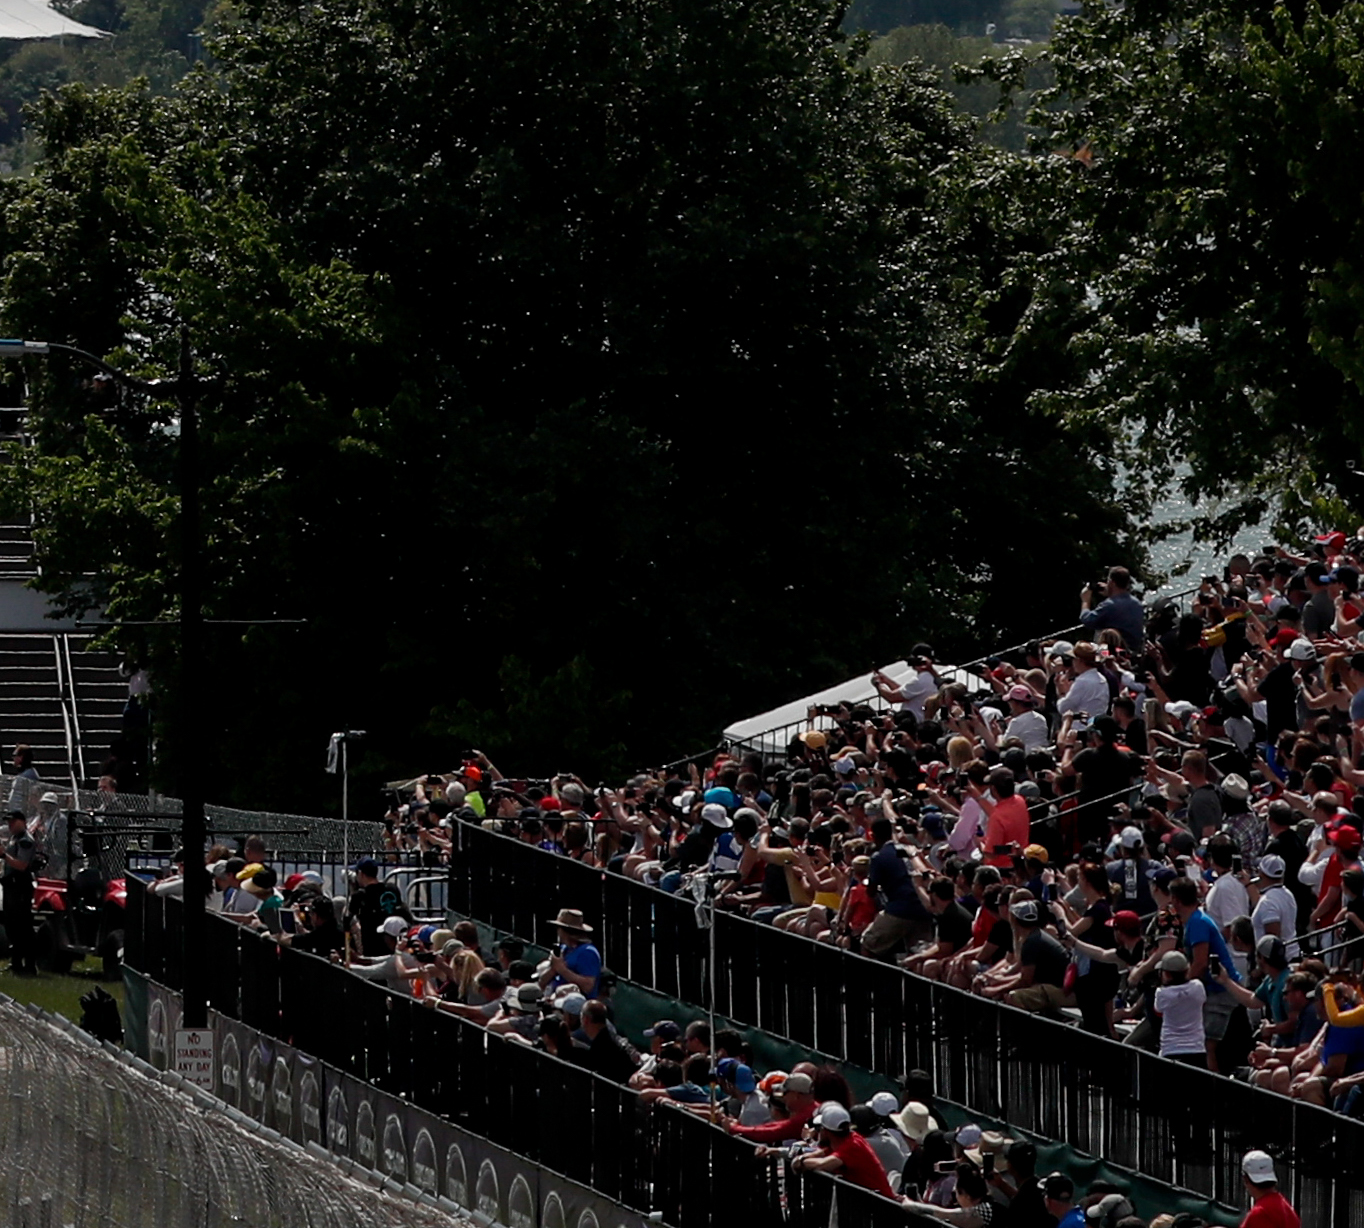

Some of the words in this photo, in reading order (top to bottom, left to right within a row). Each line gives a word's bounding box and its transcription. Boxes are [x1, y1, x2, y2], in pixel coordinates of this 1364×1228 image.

[187, 1034, 201, 1045] NO
[177, 1048, 212, 1059] STANDING
[178, 1062, 193, 1072] ANY
[196, 1062, 211, 1072] DAY
